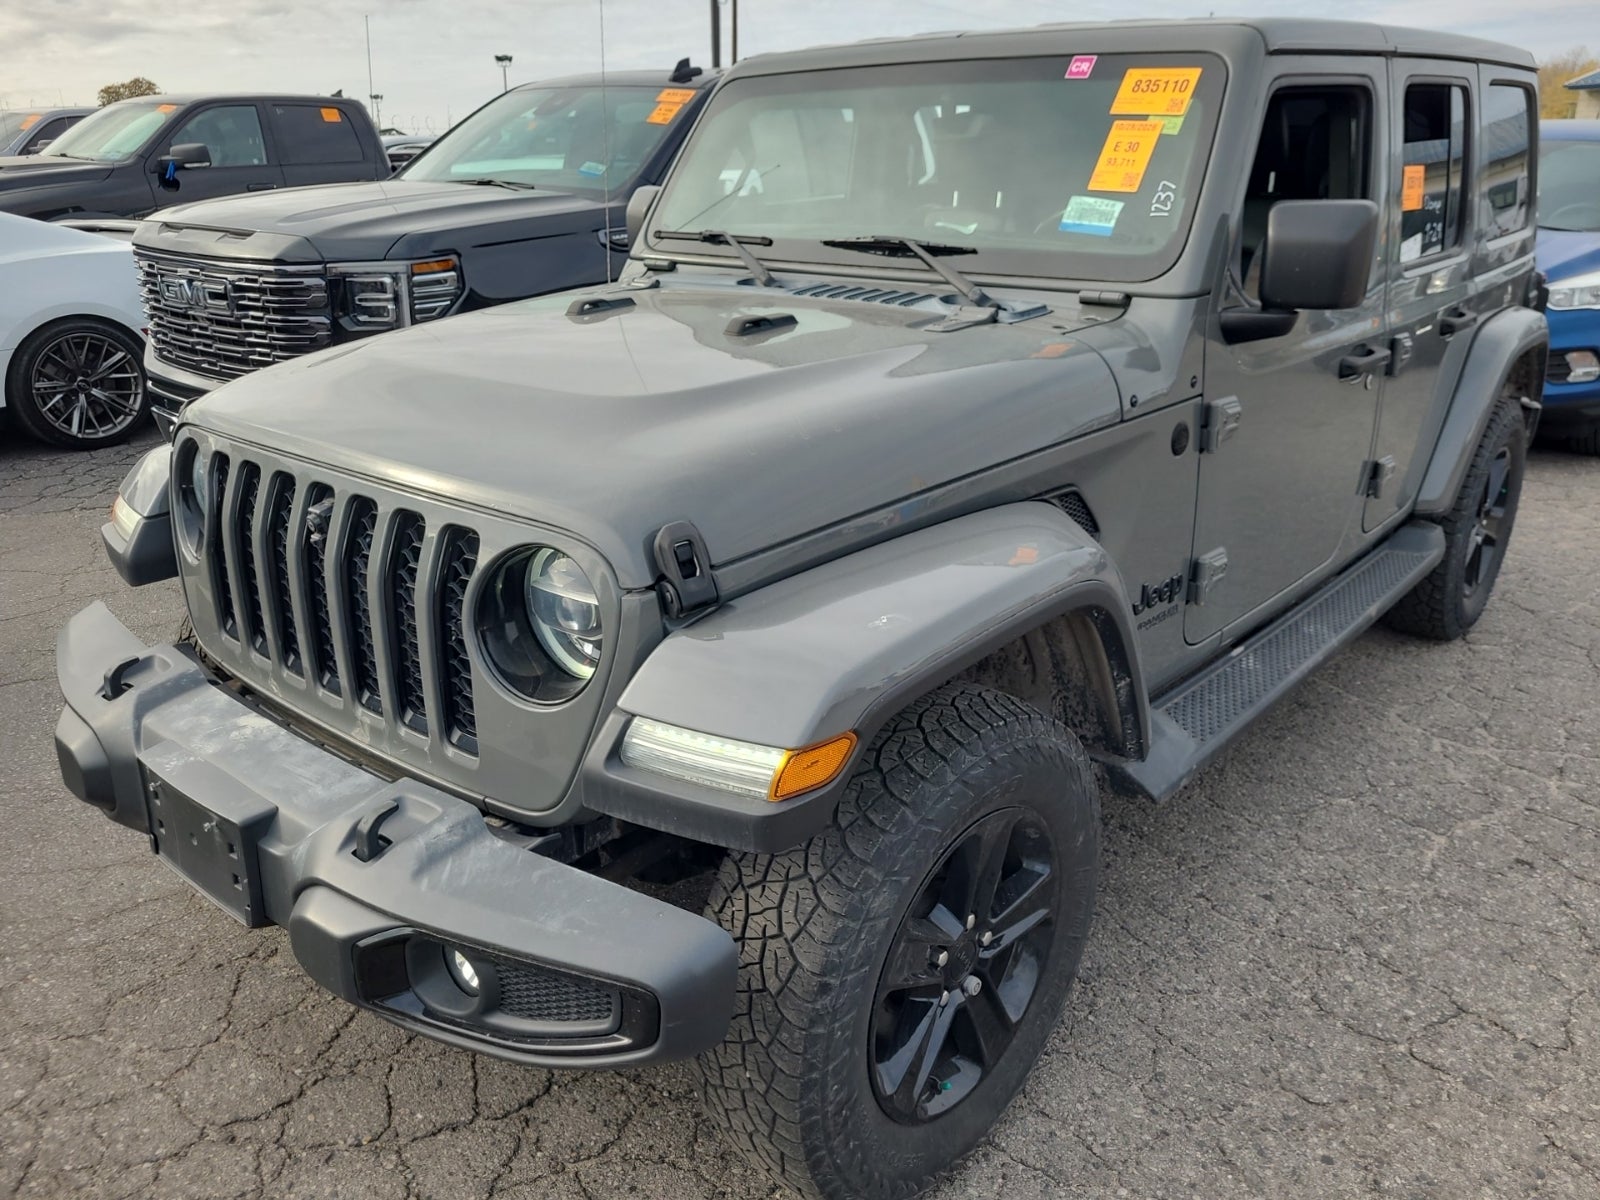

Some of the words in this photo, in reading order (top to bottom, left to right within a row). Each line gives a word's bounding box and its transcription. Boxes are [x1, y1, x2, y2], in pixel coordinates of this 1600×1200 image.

[1071, 61, 1090, 73] CR
[1131, 79, 1190, 93] 835110
[1113, 141, 1122, 152] E
[1124, 141, 1140, 152] 30
[1150, 180, 1176, 216] 1237
[160, 279, 228, 310] GMC
[1132, 573, 1183, 616] Jeep
